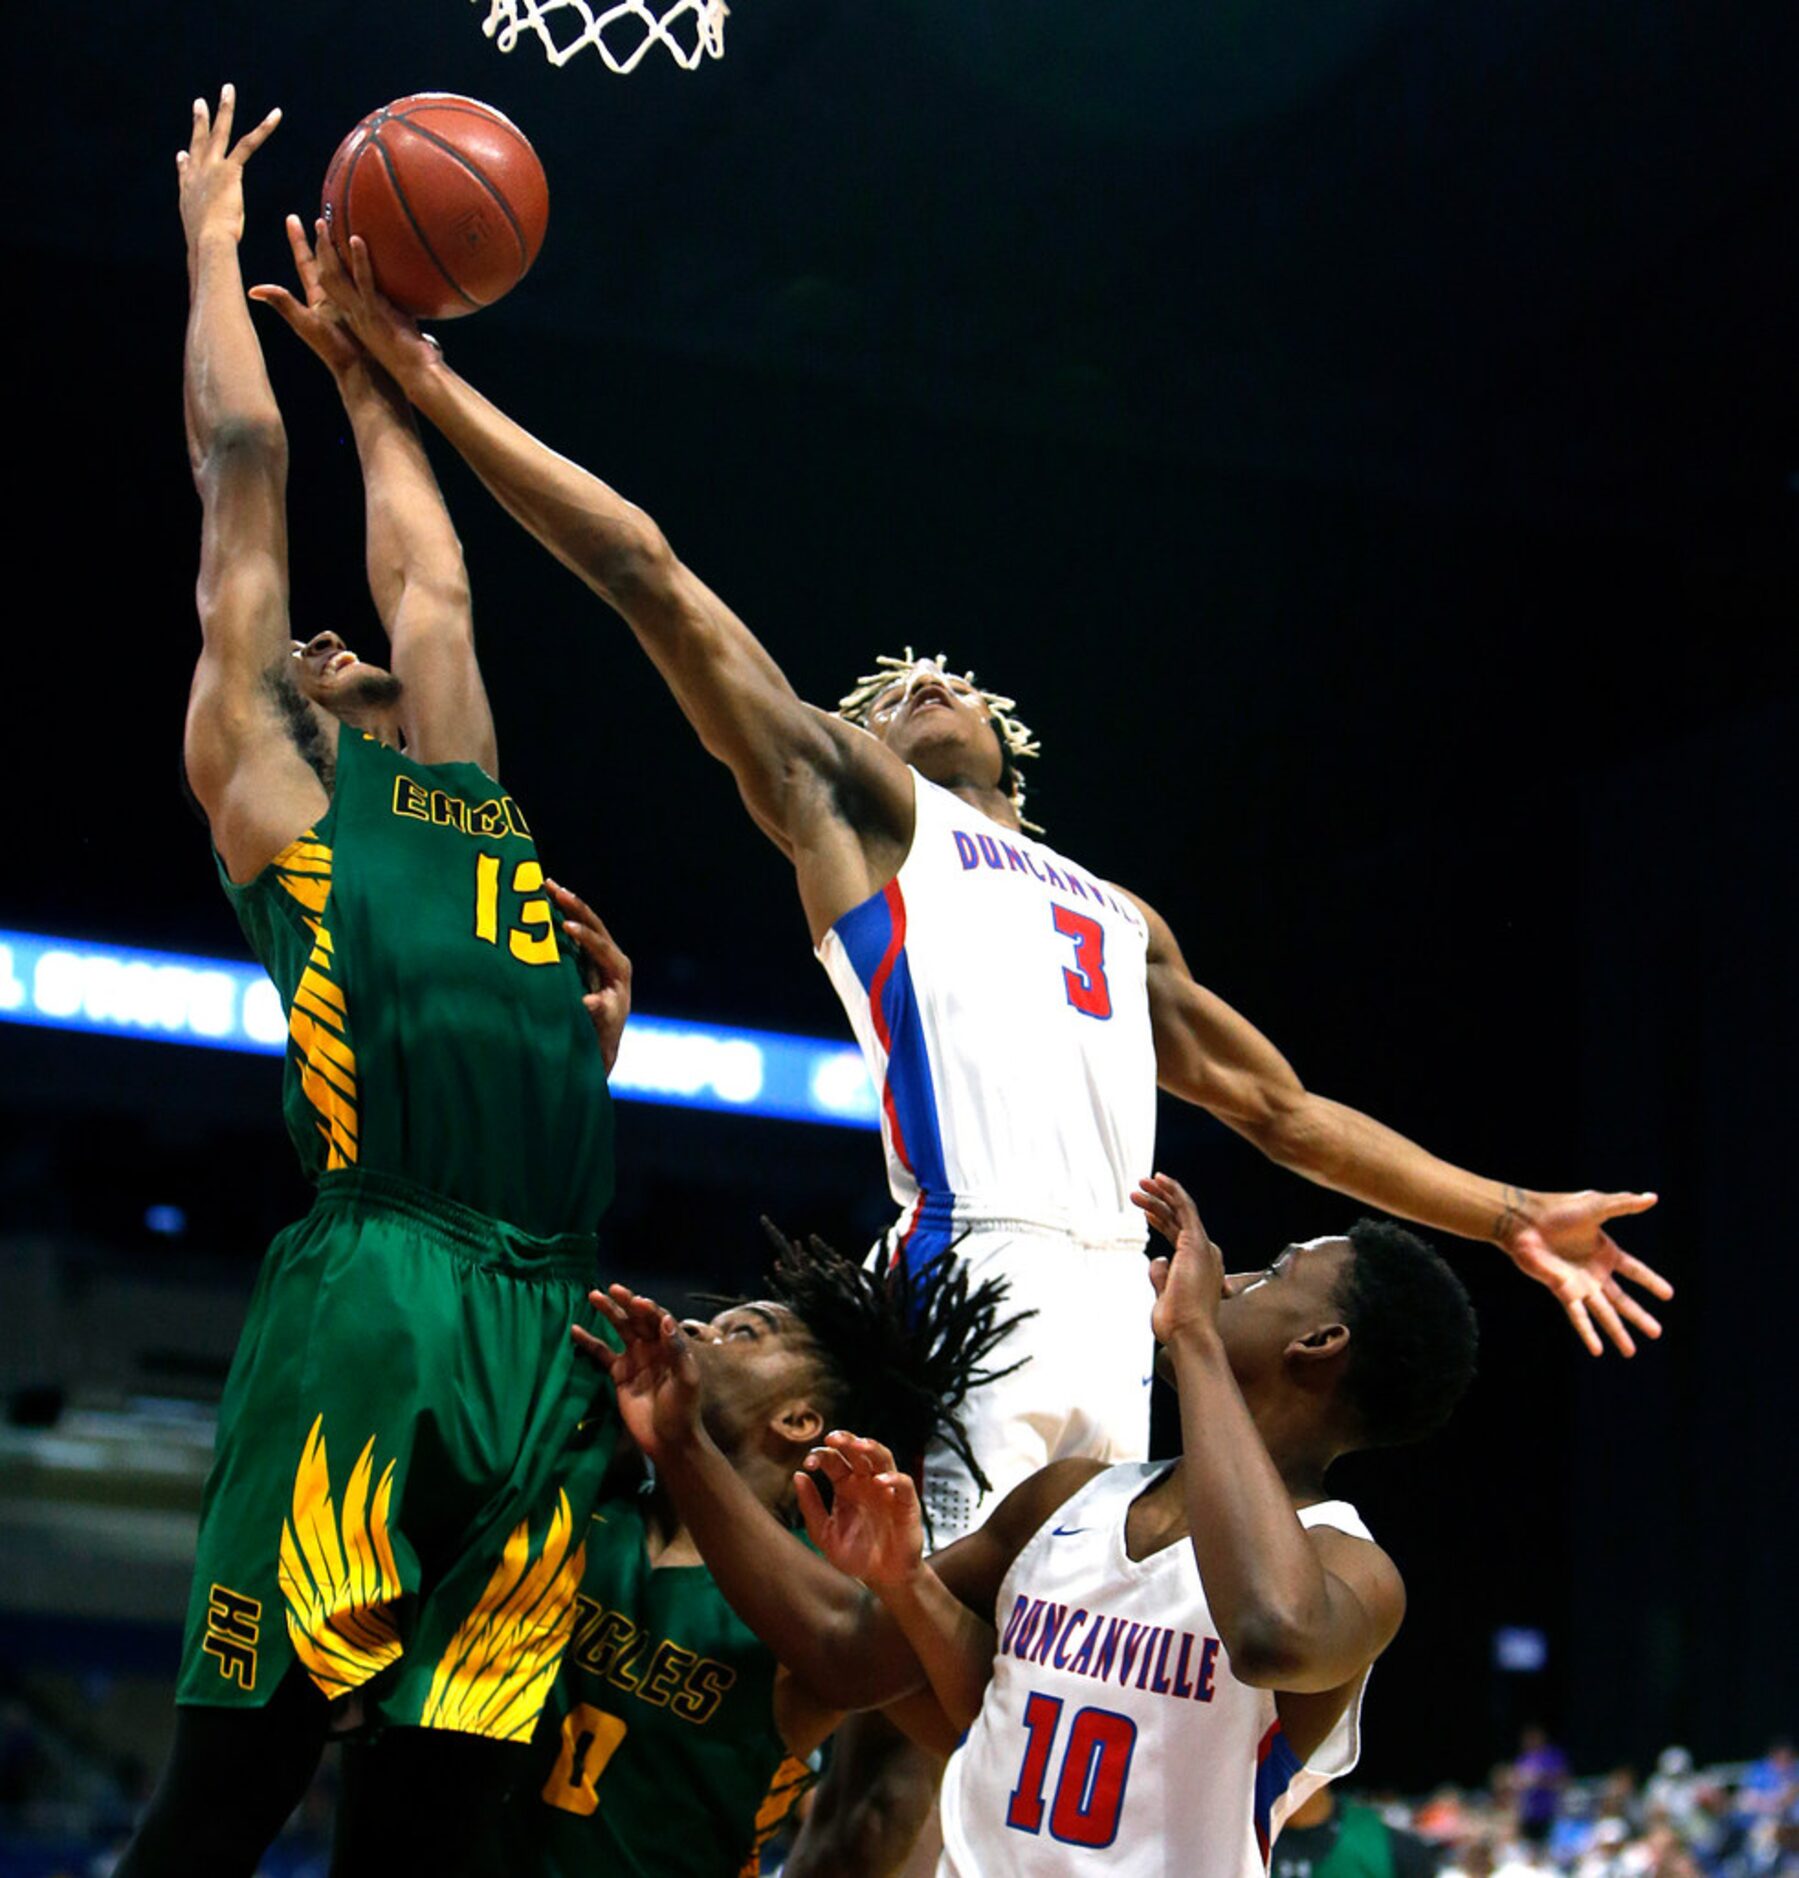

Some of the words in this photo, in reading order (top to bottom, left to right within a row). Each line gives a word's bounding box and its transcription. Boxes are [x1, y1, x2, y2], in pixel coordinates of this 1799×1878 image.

[475, 853, 561, 965] 13
[1050, 901, 1113, 1020] 3
[202, 1583, 262, 1691] HF
[1001, 1594, 1220, 1704] DUNCANVILLE
[541, 1702, 628, 1818] 0
[1005, 1690, 1138, 1851] 10
